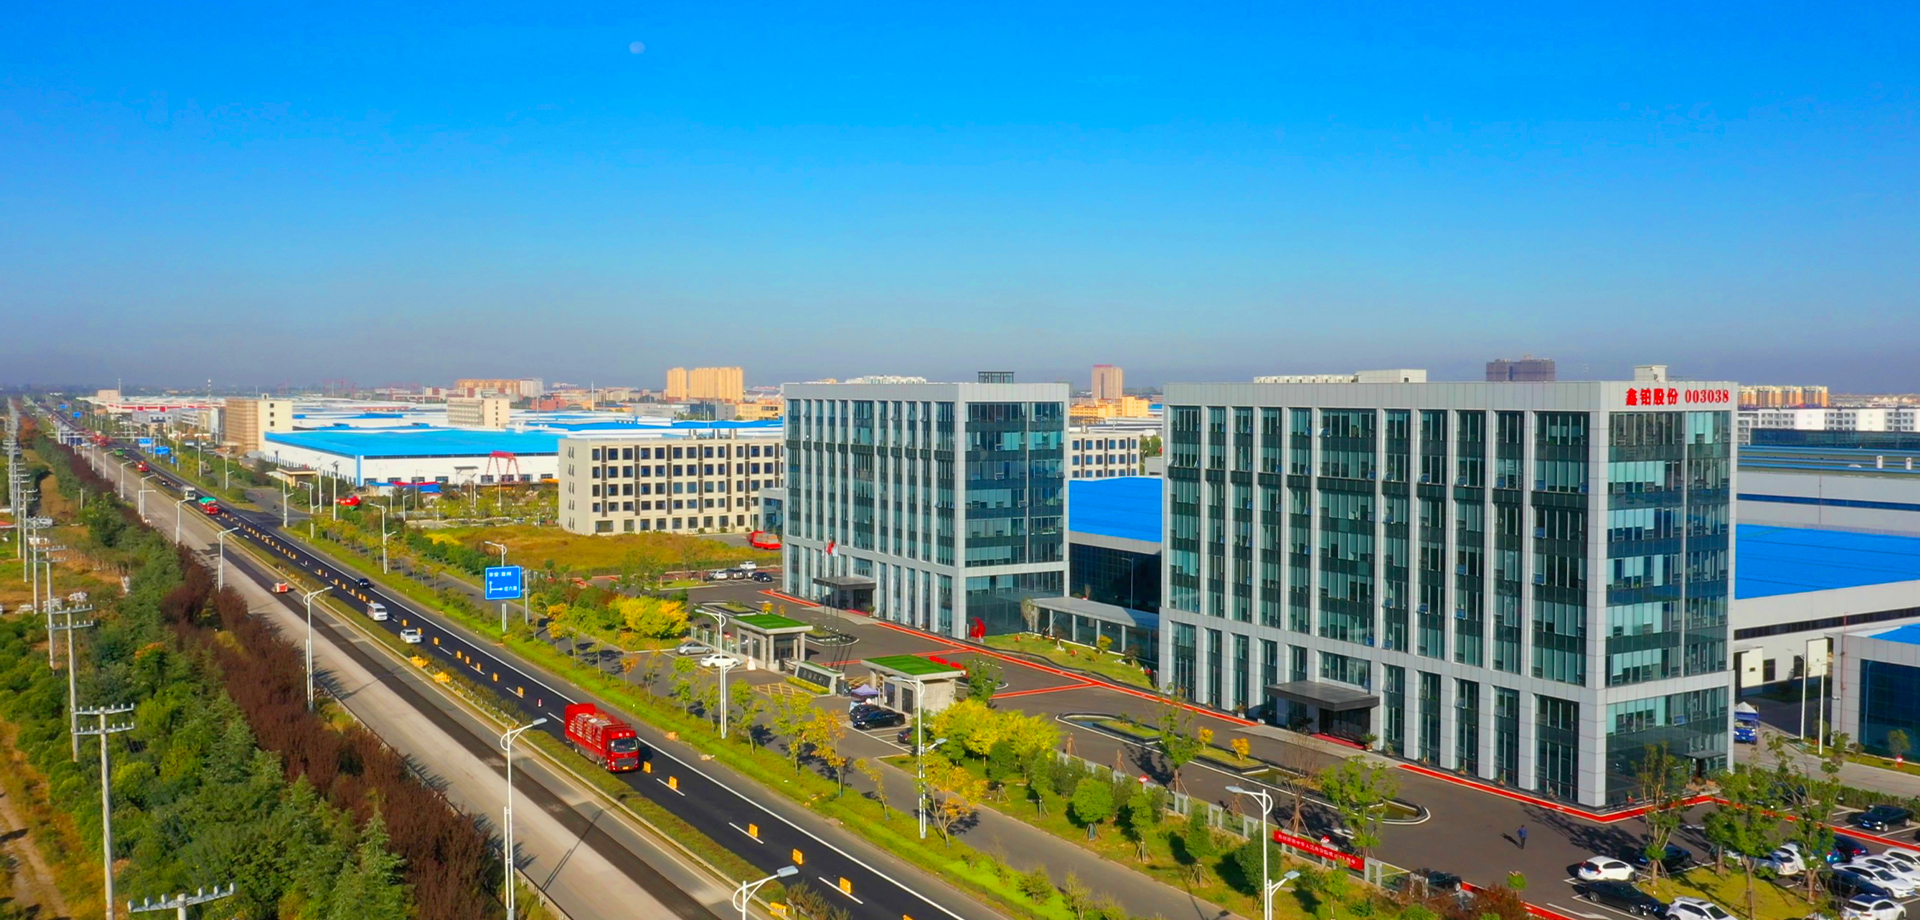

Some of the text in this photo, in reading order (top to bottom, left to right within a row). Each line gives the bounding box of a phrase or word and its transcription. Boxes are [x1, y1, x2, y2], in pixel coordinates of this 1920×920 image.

[1626, 388, 1730, 406] 鑫铂股份 003038
